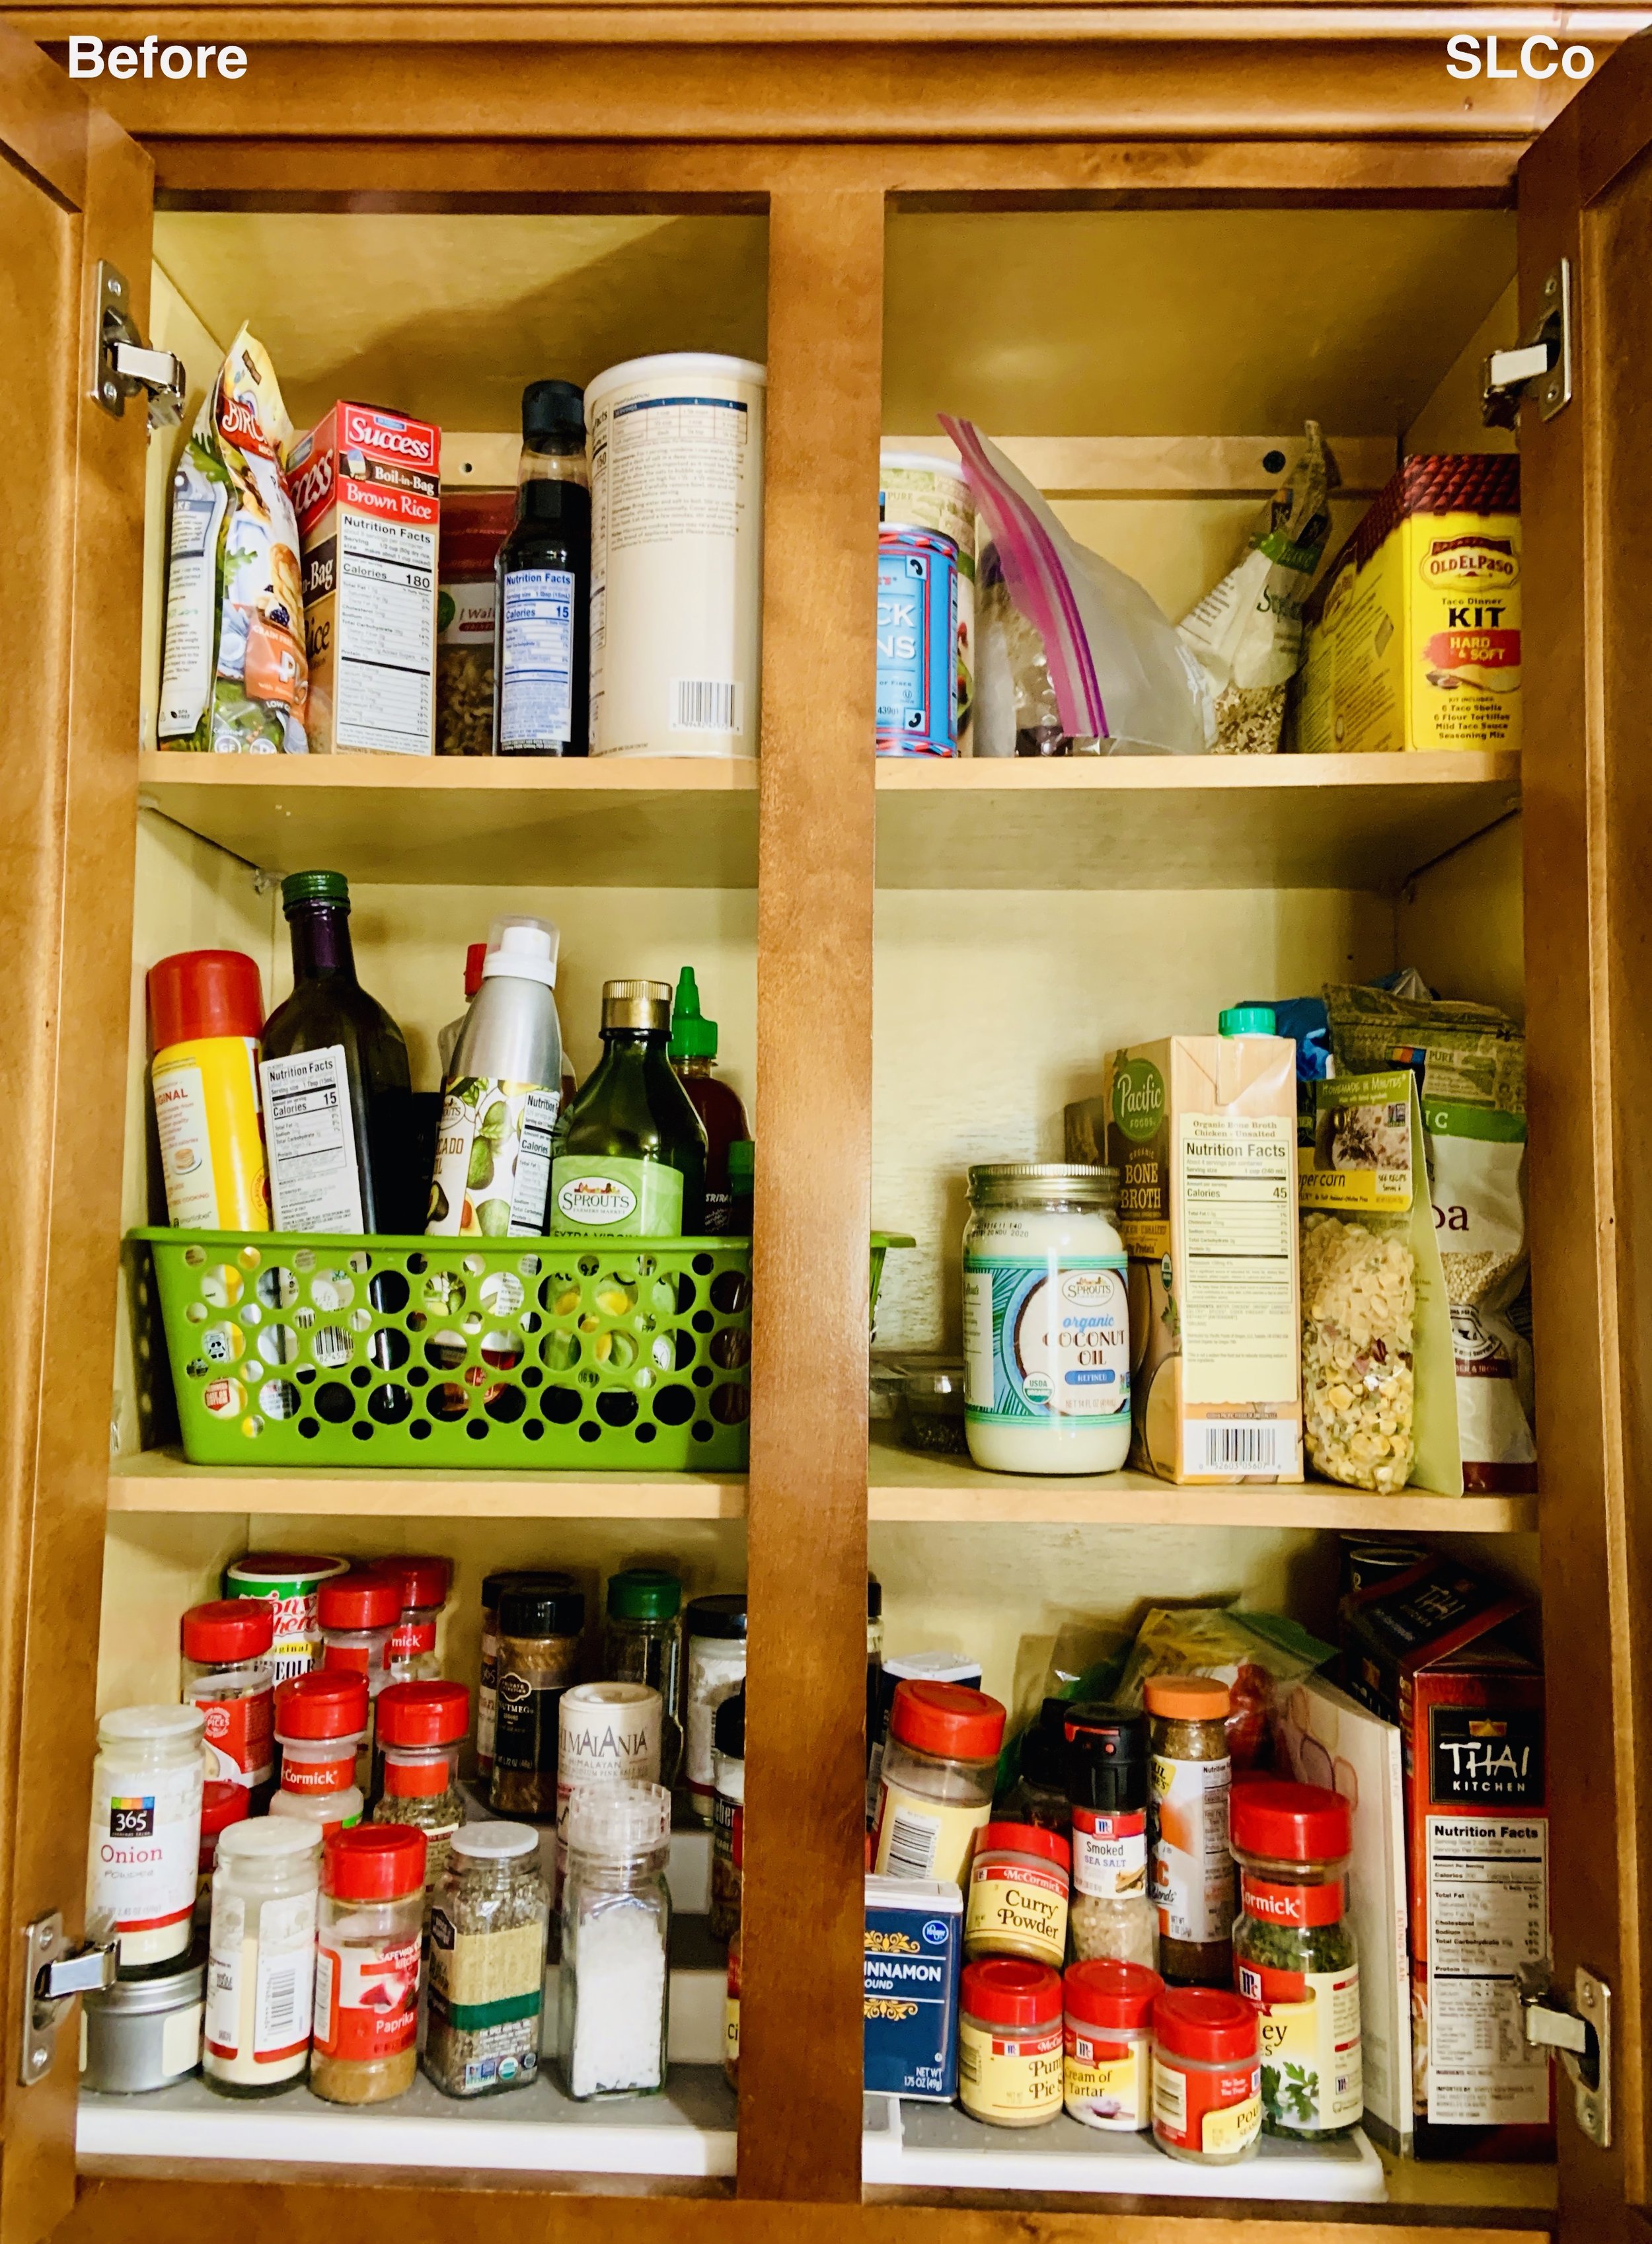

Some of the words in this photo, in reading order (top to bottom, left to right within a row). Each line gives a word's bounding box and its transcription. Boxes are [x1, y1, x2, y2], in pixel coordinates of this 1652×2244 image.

[350, 418, 430, 459] Success
[375, 466, 434, 496] Boil-in-Bag
[347, 483, 397, 511] Brown
[401, 496, 432, 519] Rice
[344, 516, 396, 535] Nutrition
[400, 529, 431, 543] Facts
[344, 563, 387, 580] Calories
[406, 574, 430, 588] 180
[507, 574, 542, 585] Nutrition
[545, 573, 571, 585] Facts
[506, 608, 535, 619] Calories
[556, 606, 569, 618] 15
[1448, 607, 1506, 628] KIT
[1450, 637, 1490, 648] HARD
[1470, 648, 1506, 660] SOFT
[266, 701, 283, 710] LOW
[1429, 1050, 1454, 1063] PURE
[270, 1066, 307, 1082] Nutrition
[309, 1060, 333, 1073] Facts
[527, 1095, 555, 1111] Nutrition
[1117, 1073, 1162, 1118] Pacific
[274, 1103, 307, 1117] Calories
[324, 1092, 336, 1105] 15
[1130, 1117, 1156, 1129] FOODS
[521, 1140, 548, 1154] Calories
[1187, 1142, 1242, 1156] Nutrition
[1248, 1144, 1285, 1157] Facts
[1125, 1162, 1158, 1185] BONE
[1320, 1174, 1345, 1187] corn
[1121, 1188, 1161, 1209] BROTH
[1187, 1188, 1220, 1197] Calories
[1273, 1187, 1287, 1198] 45
[562, 1192, 629, 1211] SPROUTS
[1068, 1284, 1111, 1298] SPROUTS
[1063, 1314, 1115, 1333] organic
[1042, 1329, 1125, 1348] COCONUT
[1077, 1350, 1106, 1366] OIL
[568, 1758, 621, 1769] HIMALAYAN
[1439, 1742, 1530, 1779] THAI
[1203, 1765, 1226, 1774] Nutrition
[1453, 1781, 1526, 1793] KITCHEN
[116, 1811, 147, 1832] 365
[1435, 1825, 1496, 1838] Nutrition
[1501, 1826, 1538, 1838] Facts
[101, 1844, 163, 1863] Onion
[1087, 1841, 1123, 1856] Smoked
[1084, 1855, 1100, 1866] SEA
[1004, 1869, 1063, 1896] McCormick
[1005, 1889, 1059, 1920] Curry
[997, 1908, 1059, 1940] Powder
[927, 1925, 946, 1940] Kroger
[1398, 1955, 1406, 1983] PLAN
[376, 2012, 414, 2034] Paprika
[916, 2067, 930, 2077] NET
[930, 2068, 943, 2079] WT
[1064, 2068, 1096, 2083] Cream
[1098, 2070, 1113, 2083] of
[916, 2077, 926, 2088] OZ
[1029, 2080, 1055, 2099] Pie
[1069, 2081, 1105, 2097] Tartar
